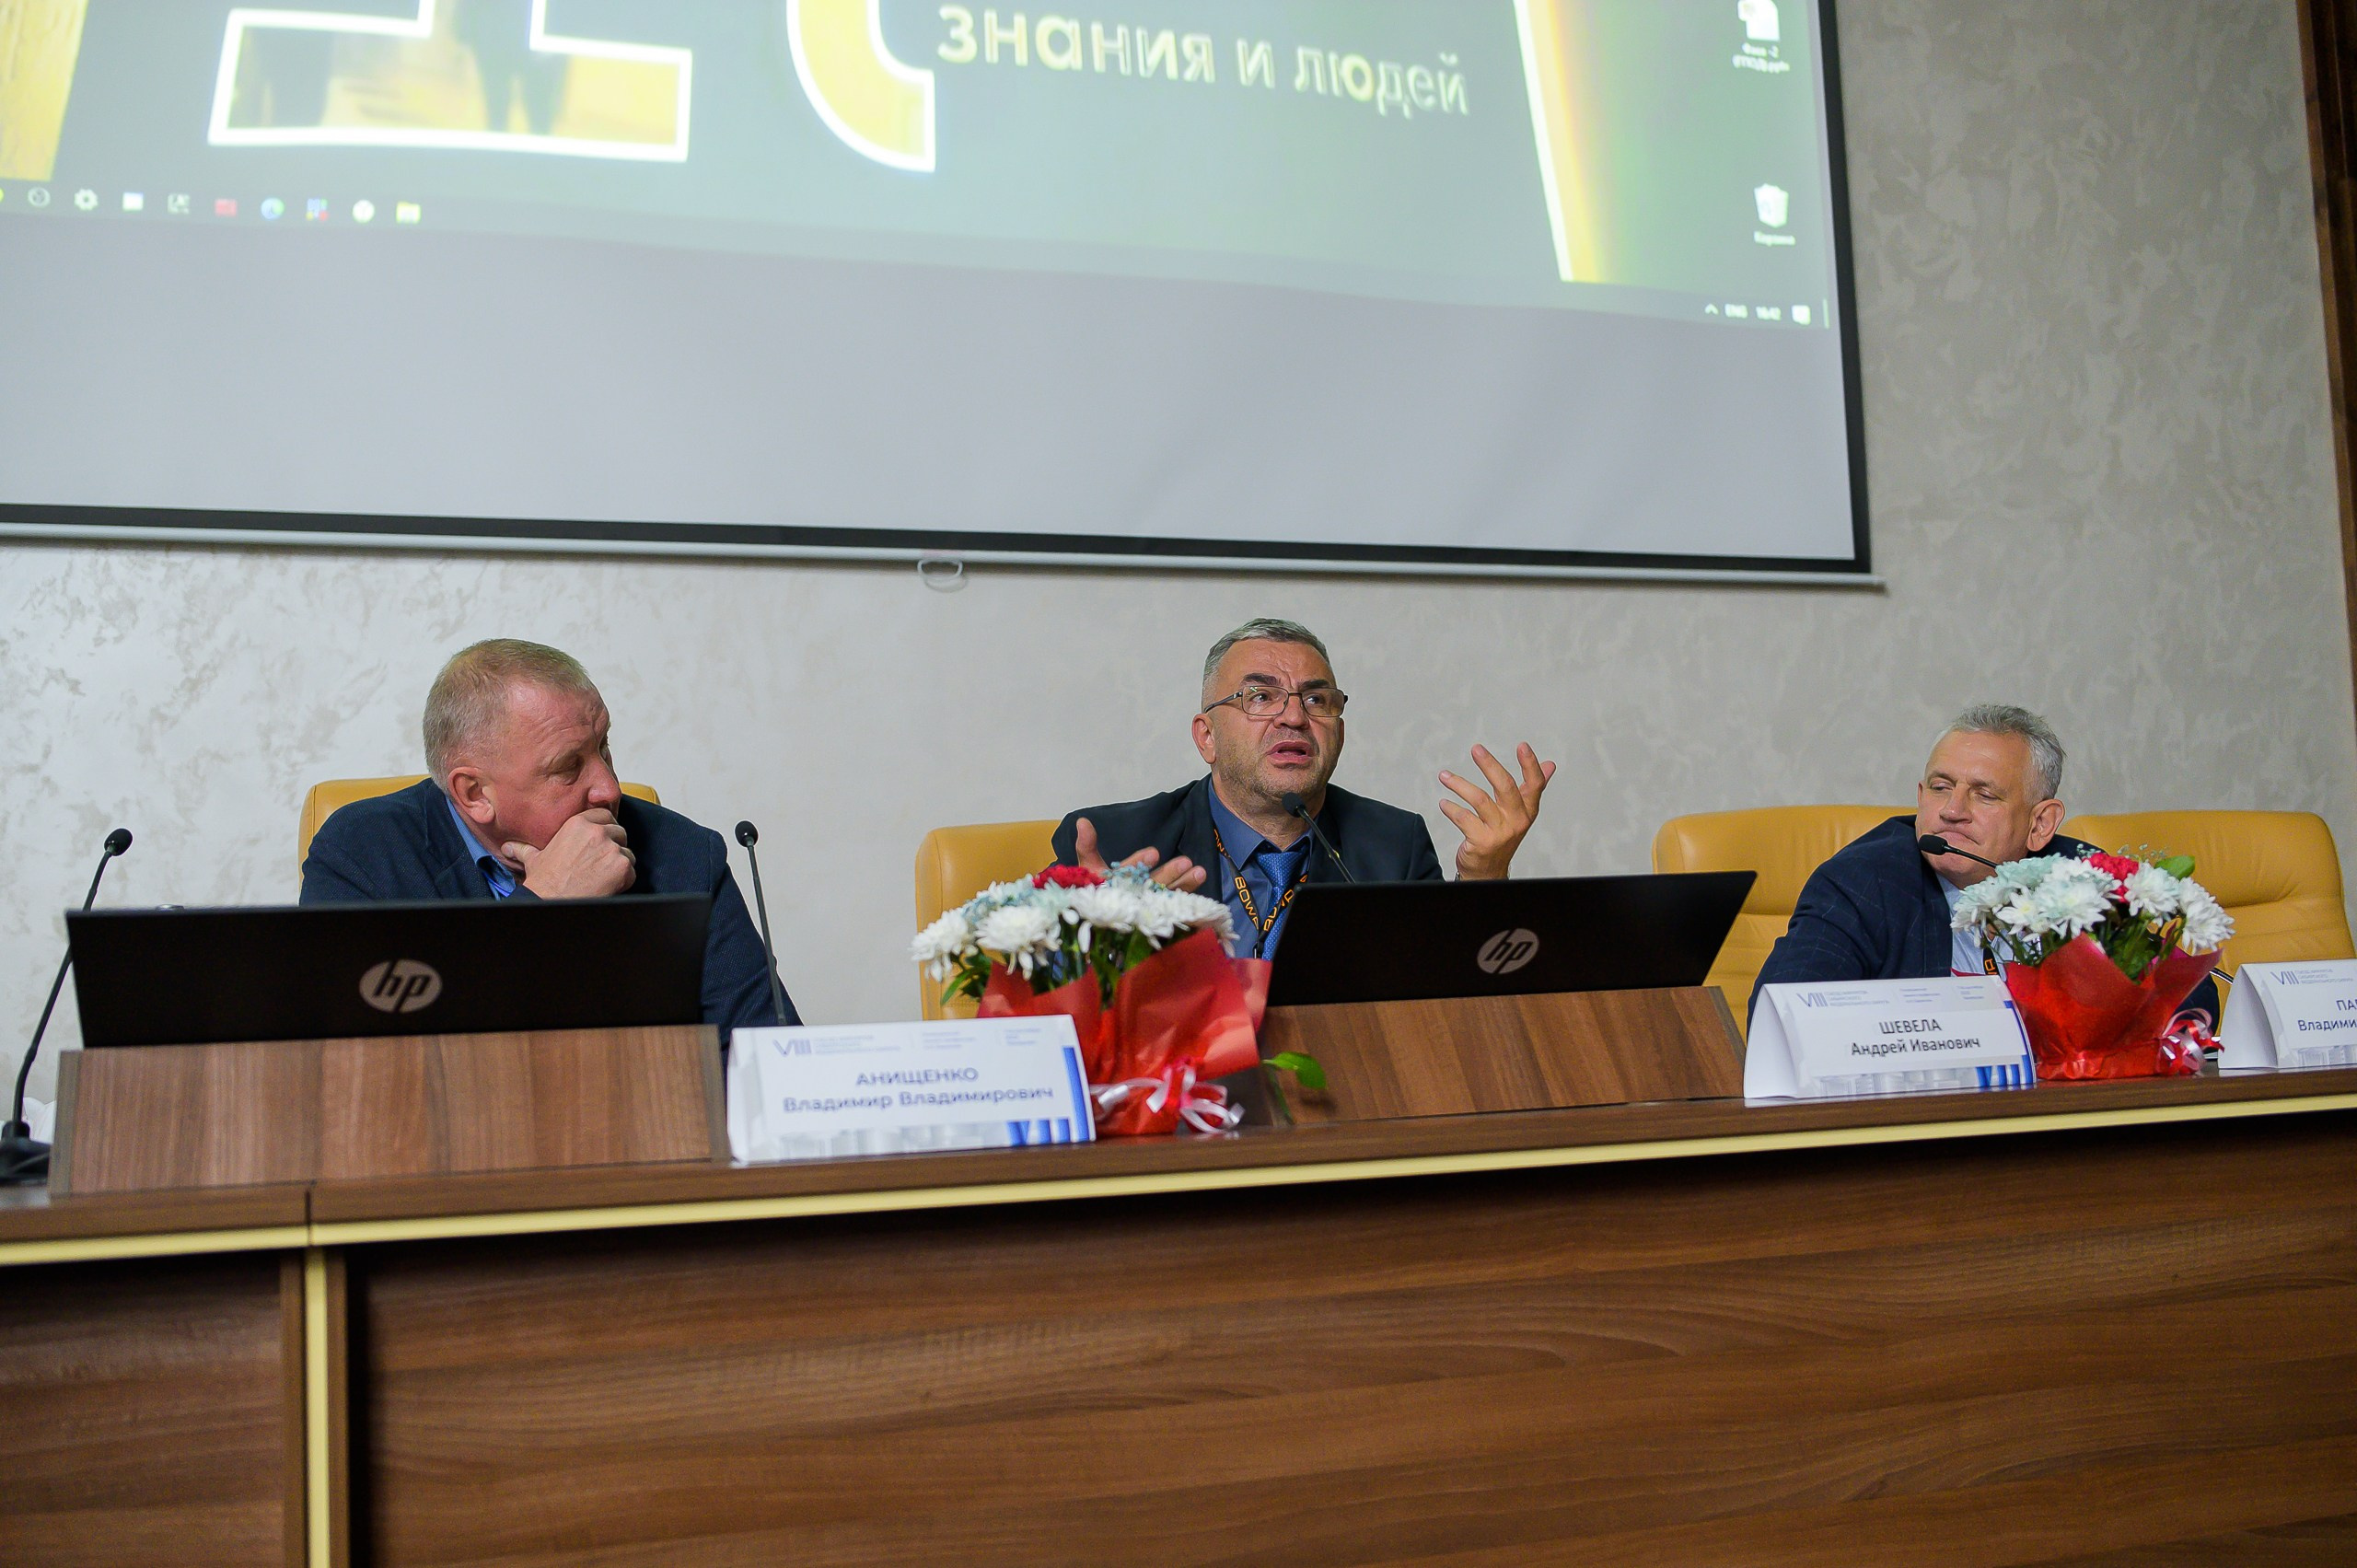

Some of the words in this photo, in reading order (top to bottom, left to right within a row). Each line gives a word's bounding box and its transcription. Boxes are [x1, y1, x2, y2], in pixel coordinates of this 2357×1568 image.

[1482, 928, 1534, 973] hp
[372, 958, 431, 1013] hp
[2336, 998, 2357, 1011] ПА
[1879, 1018, 1942, 1035] ШЕВЕЛА
[1851, 1040, 1908, 1058] Андрей
[1911, 1037, 1980, 1053] Иванович
[855, 1067, 979, 1087] АНИЩЕНКО
[783, 1096, 893, 1113] Владимир
[899, 1087, 1053, 1107] Владимирович
